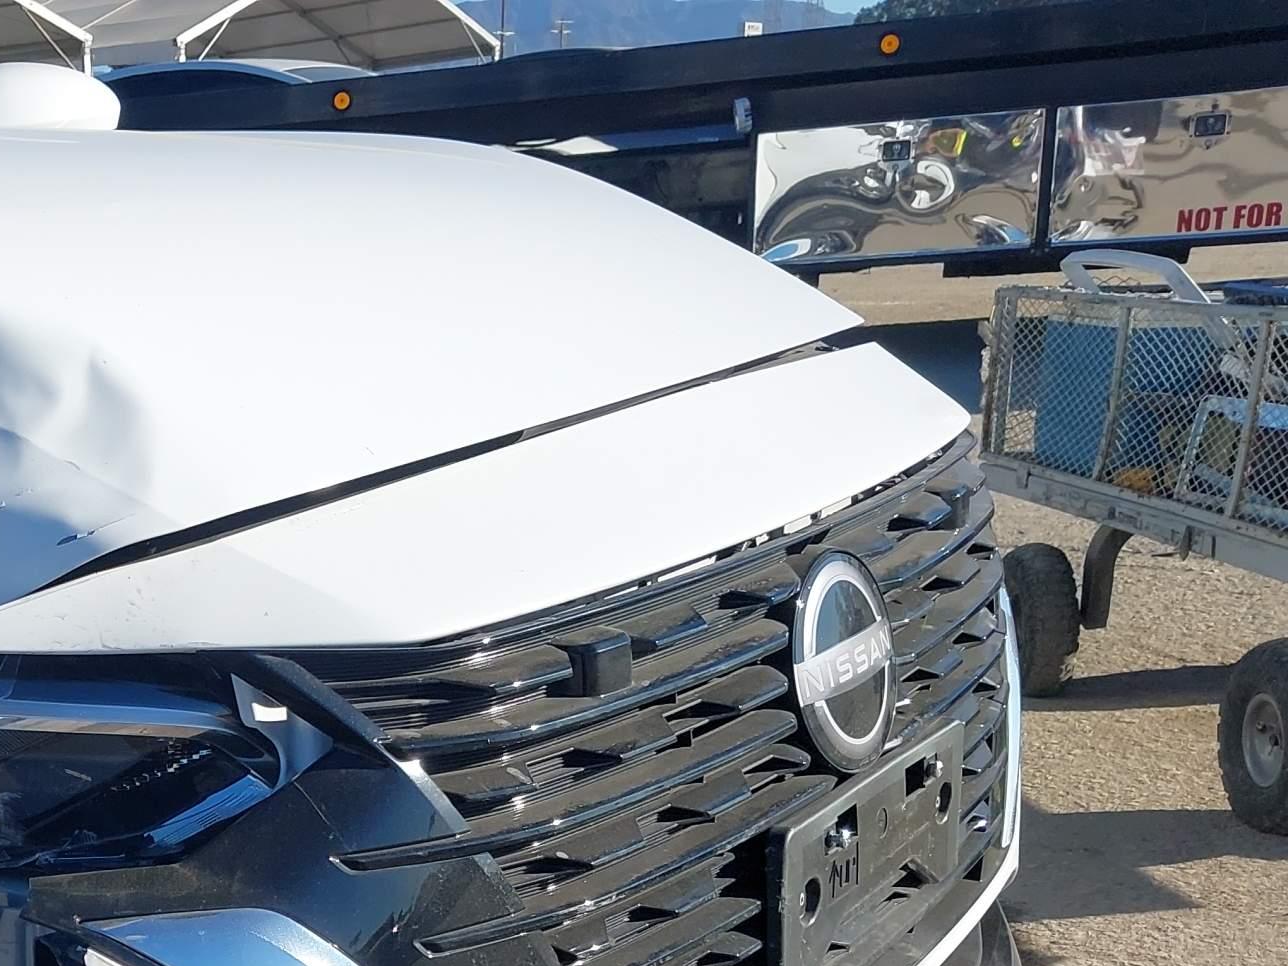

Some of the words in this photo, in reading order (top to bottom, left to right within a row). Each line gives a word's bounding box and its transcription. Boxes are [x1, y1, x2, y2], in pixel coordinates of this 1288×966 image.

[1176, 206, 1228, 233] NOT
[1232, 202, 1283, 229] FOR
[802, 624, 891, 698] NISSAN
